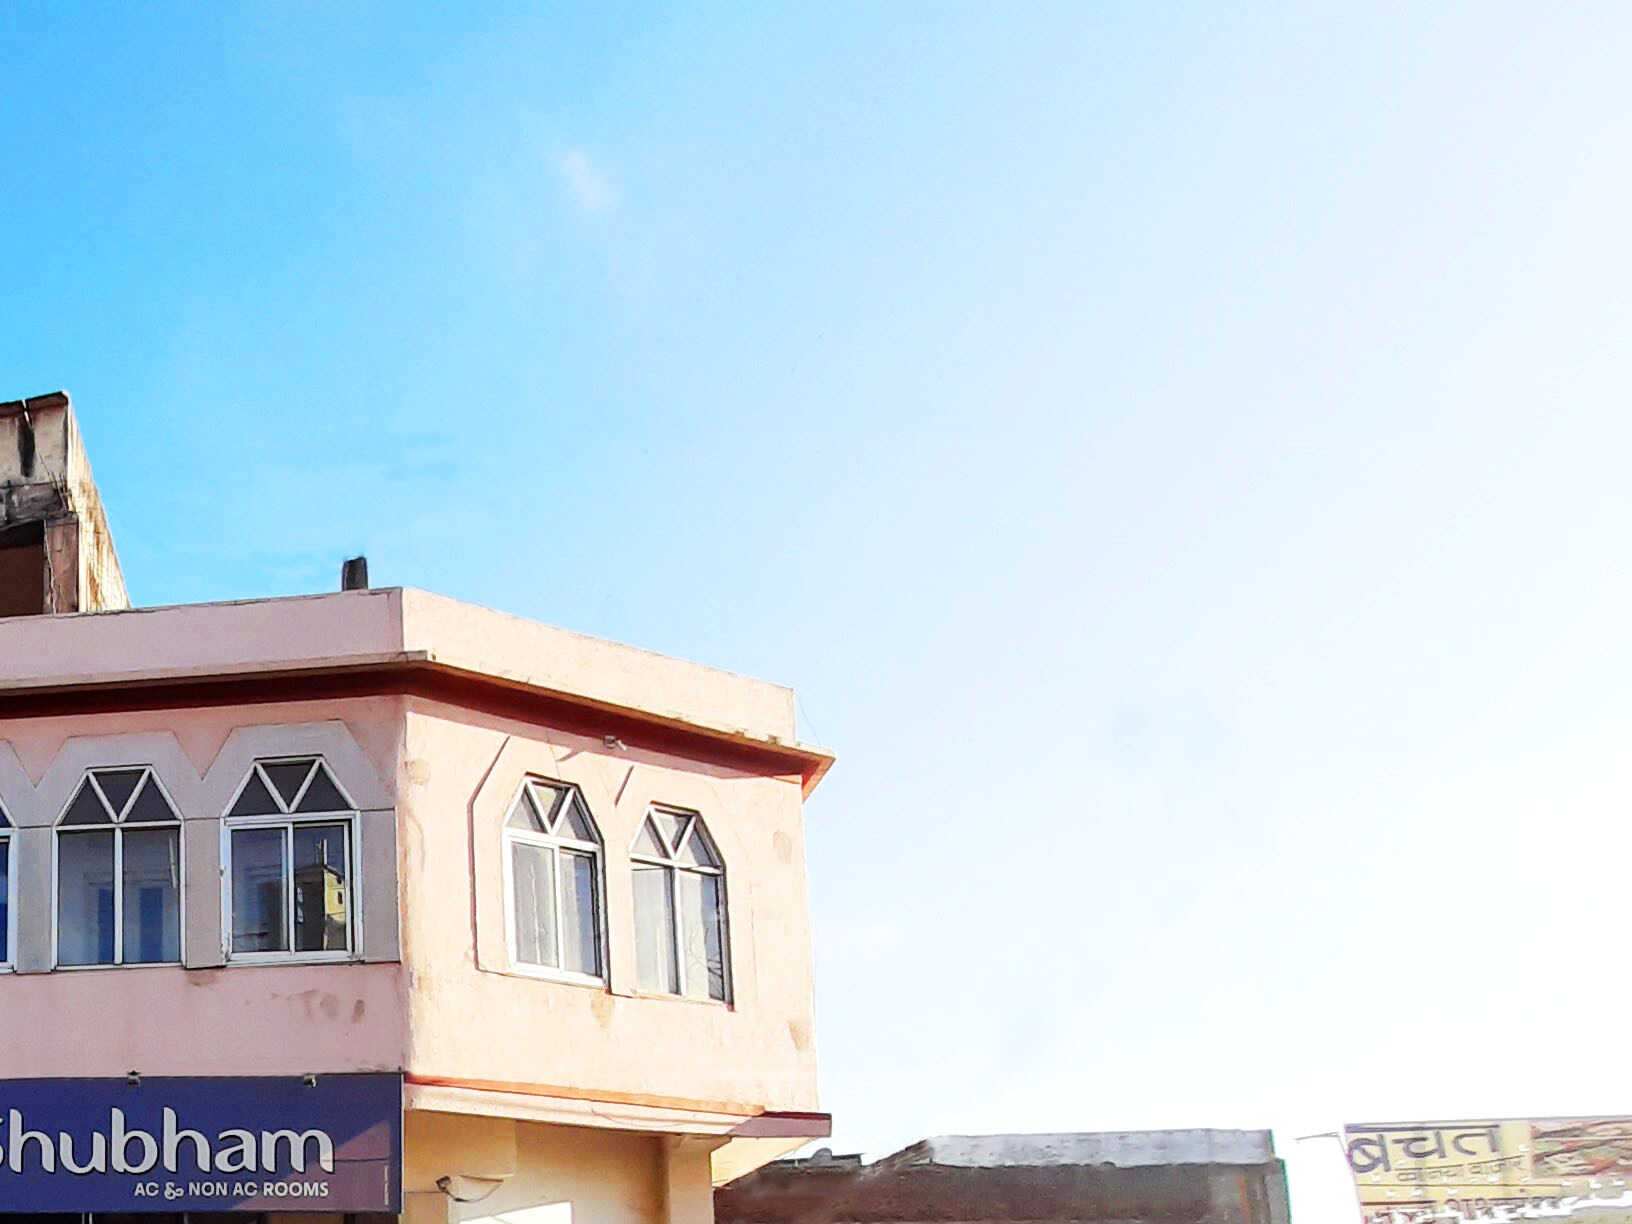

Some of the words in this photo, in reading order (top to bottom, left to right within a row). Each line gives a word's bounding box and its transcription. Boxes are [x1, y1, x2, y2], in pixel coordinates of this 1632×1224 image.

[1345, 1125, 1501, 1174] बचत
[134, 1182, 159, 1198] AC
[165, 1182, 184, 1200] &
[188, 1182, 228, 1198] NON
[232, 1182, 258, 1198] AC
[263, 1181, 329, 1198] ROOMS
